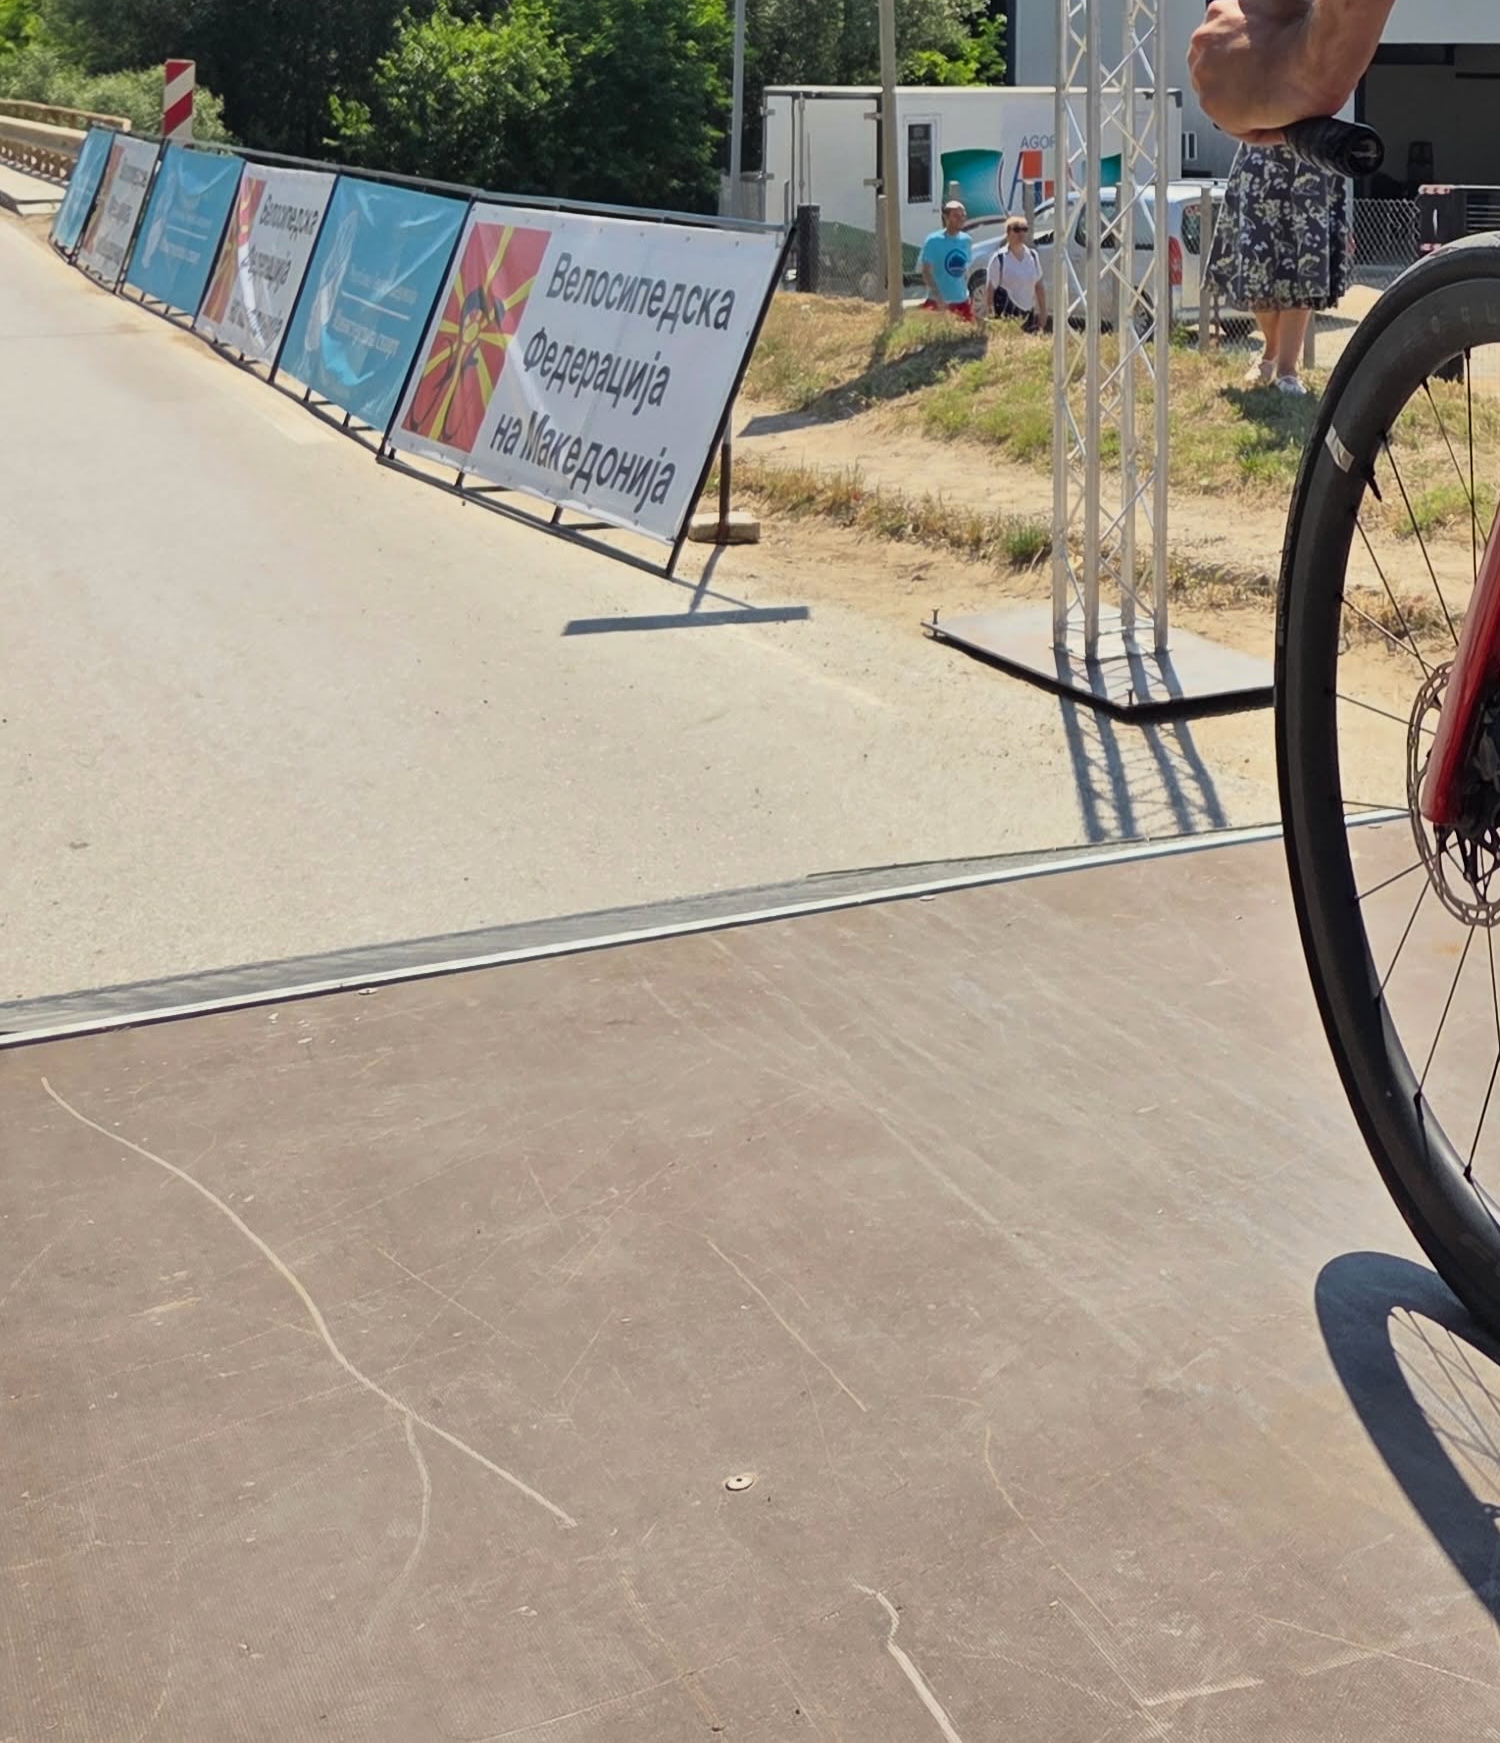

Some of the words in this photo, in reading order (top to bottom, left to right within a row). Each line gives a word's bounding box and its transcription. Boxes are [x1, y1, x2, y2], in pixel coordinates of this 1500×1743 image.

[546, 252, 735, 334] Велосипедска
[522, 327, 671, 416] Федерација
[489, 413, 523, 455] на
[519, 410, 676, 513] Македонија
